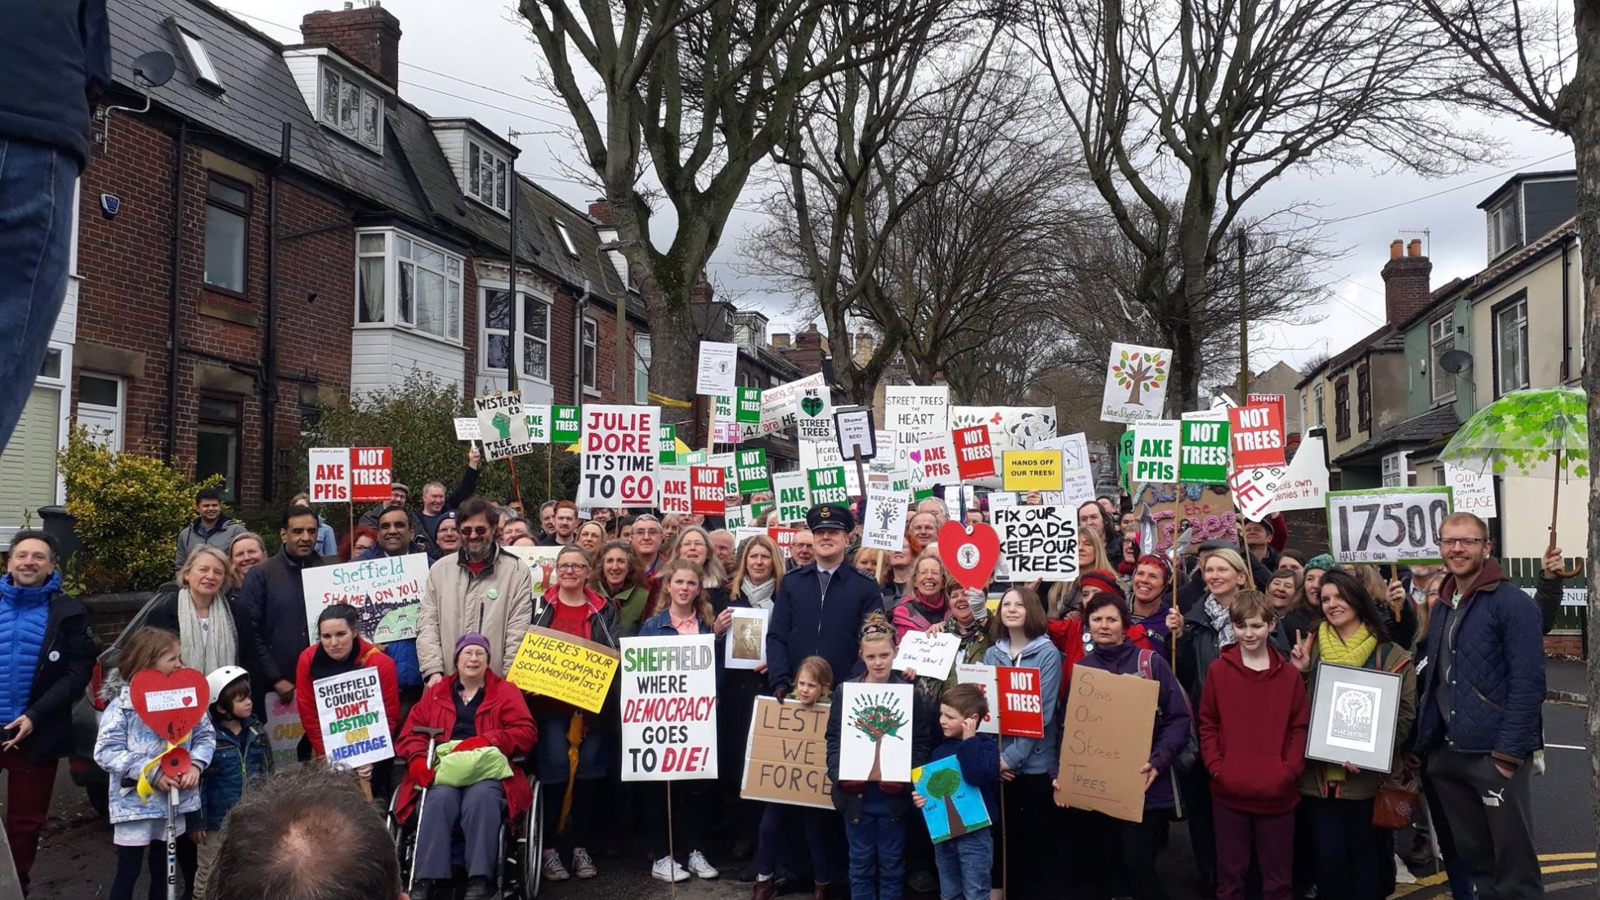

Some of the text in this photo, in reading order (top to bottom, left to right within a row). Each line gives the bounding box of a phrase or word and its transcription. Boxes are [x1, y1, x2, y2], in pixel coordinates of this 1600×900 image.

[716, 395, 731, 405] AXE
[744, 389, 758, 400] NOT
[805, 388, 818, 397] WE
[886, 396, 944, 406] STREET TREES
[476, 394, 522, 411] WESTERN
[509, 406, 523, 416] RD.
[715, 406, 732, 416] PFIs
[741, 400, 760, 412] TREES
[559, 408, 575, 419] NOT
[587, 412, 651, 431] JULIE
[898, 413, 935, 425] HEART
[1239, 408, 1269, 429] NOT
[555, 420, 578, 431] TREES
[762, 420, 779, 433] are
[799, 419, 830, 427] STREET
[529, 427, 544, 438] FIs
[802, 428, 830, 438] TREES
[964, 430, 983, 445] NOT
[1190, 423, 1221, 443] NOT
[1234, 430, 1281, 451] TREES
[485, 438, 512, 451] TREE
[490, 442, 533, 459] HUGGERS
[588, 433, 650, 453] DORE
[816, 447, 840, 455] SECREC
[1140, 439, 1173, 458] AXE
[358, 449, 384, 466] NOT
[686, 453, 701, 463] NOT
[741, 451, 760, 466] NOT
[924, 446, 947, 462] AXE
[961, 445, 992, 462] TREES
[1182, 446, 1226, 466] TREES
[585, 454, 654, 472] IT'S TIME
[925, 463, 950, 478] PFIs
[1137, 461, 1174, 480] PFIs
[315, 464, 344, 480] AXE
[352, 468, 391, 485] TREES
[697, 469, 718, 484] NOT
[738, 467, 767, 481] TREES
[815, 470, 838, 486] NOT
[1455, 472, 1481, 483] QUIT
[314, 484, 347, 499] PFIs
[585, 474, 654, 499] TO GO
[664, 480, 687, 495] AXE
[726, 482, 737, 494] Is
[893, 479, 910, 491] AXE
[1294, 479, 1312, 488] own
[693, 486, 724, 501] TREES
[780, 486, 806, 503] AXE
[812, 487, 847, 505] TREES
[887, 496, 906, 504] CALM
[1302, 488, 1311, 497] it
[663, 497, 689, 511] PFIs
[1183, 503, 1211, 515] the
[780, 505, 809, 521] PFIs
[995, 507, 1062, 525] FIX OUR
[728, 516, 746, 529] AXE
[1006, 521, 1075, 539] ROADS
[1339, 499, 1448, 551] 17500
[777, 531, 795, 544] NOT
[868, 532, 885, 540] SAVE
[873, 539, 892, 547] TREES
[1043, 539, 1077, 554] OUR
[1006, 555, 1077, 573] TREES
[1339, 552, 1357, 562] HALF
[1360, 552, 1369, 561] OF
[1372, 552, 1387, 560] OUR
[332, 557, 405, 586] Sheffield
[344, 575, 403, 593] City Council
[322, 592, 365, 606] SHAME
[375, 588, 394, 602] ON
[527, 634, 614, 669] WHERE'S YOUR
[624, 645, 712, 672] SHEFFIELD
[521, 649, 608, 681] MORAL COMPASS
[318, 675, 377, 698] SHEFFIELD
[636, 675, 688, 694] WHERE
[1010, 671, 1033, 691] NOT
[1078, 672, 1113, 701] Save
[325, 689, 375, 709] COUNCIL:
[1005, 692, 1041, 713] TREES
[334, 700, 368, 719] DON'T
[622, 696, 716, 724] DEMOCRACY
[1075, 705, 1103, 723] Our
[328, 711, 379, 735] DESTROY
[763, 705, 825, 733] LEST
[345, 727, 370, 744] OUR
[642, 725, 688, 744] GOES
[331, 735, 387, 760] HERITAGE
[782, 739, 816, 765] WE
[1069, 730, 1121, 759] Street
[629, 747, 709, 773] TO DIE!
[760, 764, 833, 796] FORGE
